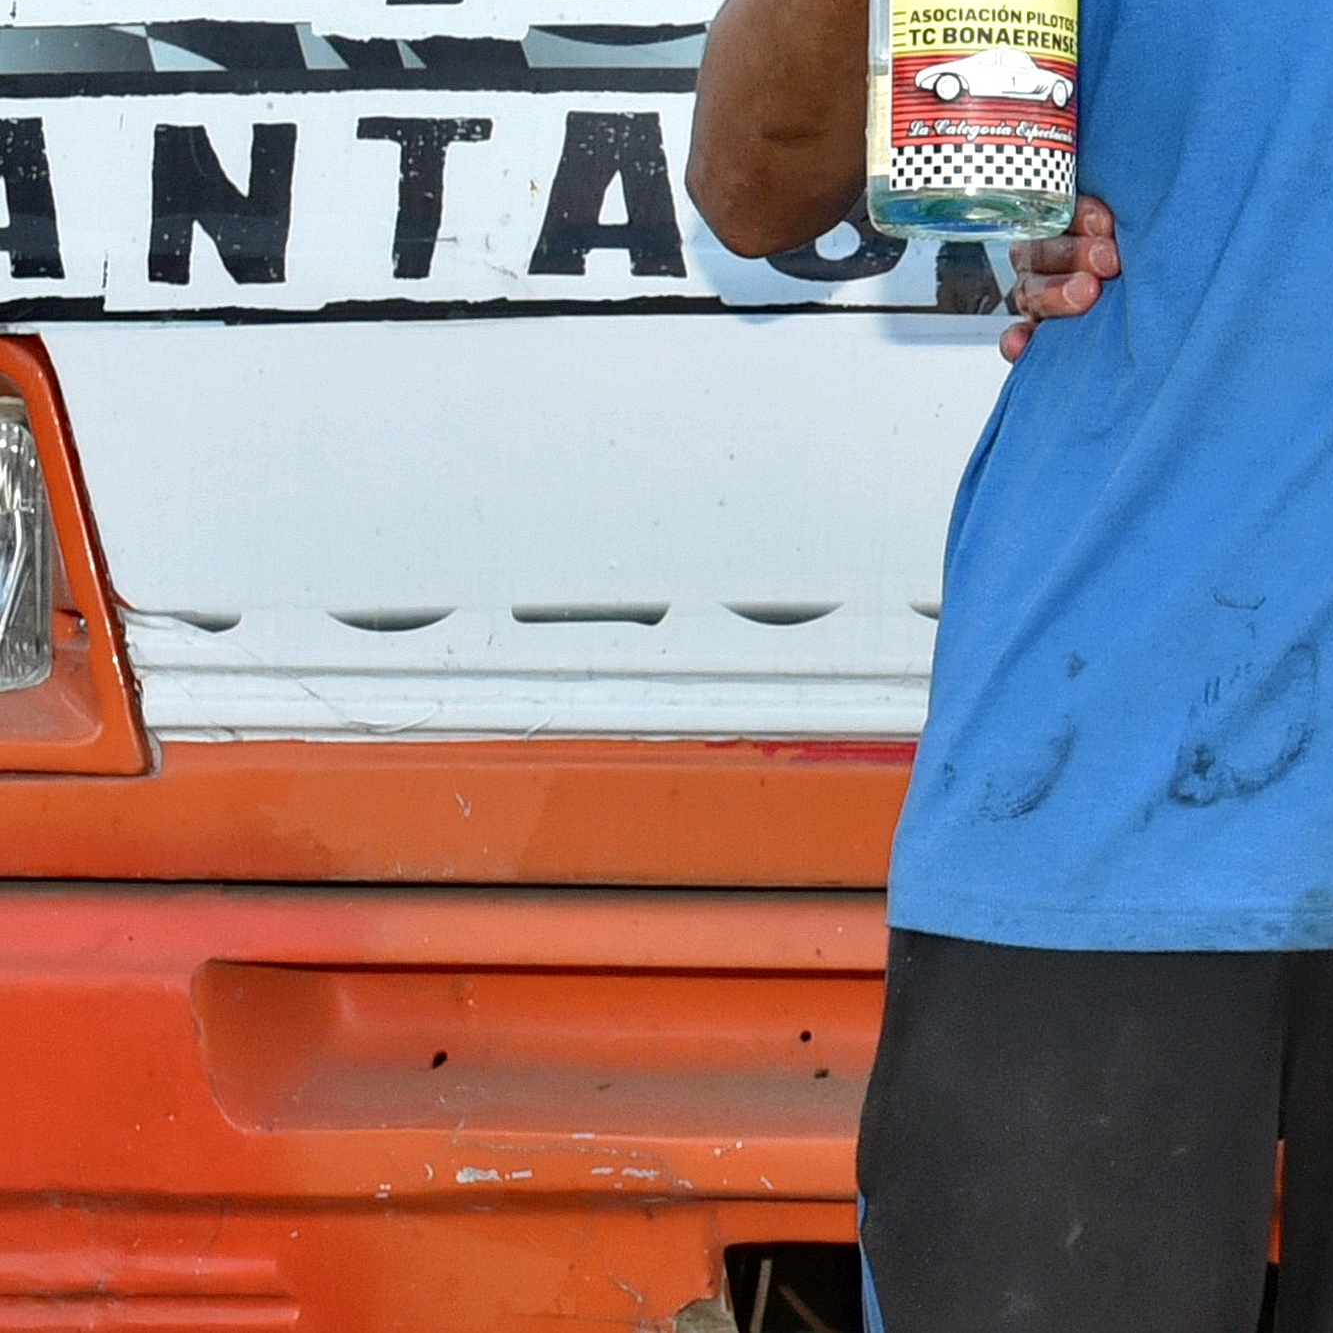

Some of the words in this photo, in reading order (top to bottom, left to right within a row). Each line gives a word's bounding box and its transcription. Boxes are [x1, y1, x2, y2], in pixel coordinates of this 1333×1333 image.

[910, 5, 1022, 24] ASOCIACIÓN
[909, 28, 936, 46] TC
[942, 27, 1075, 55] BONAERENSE
